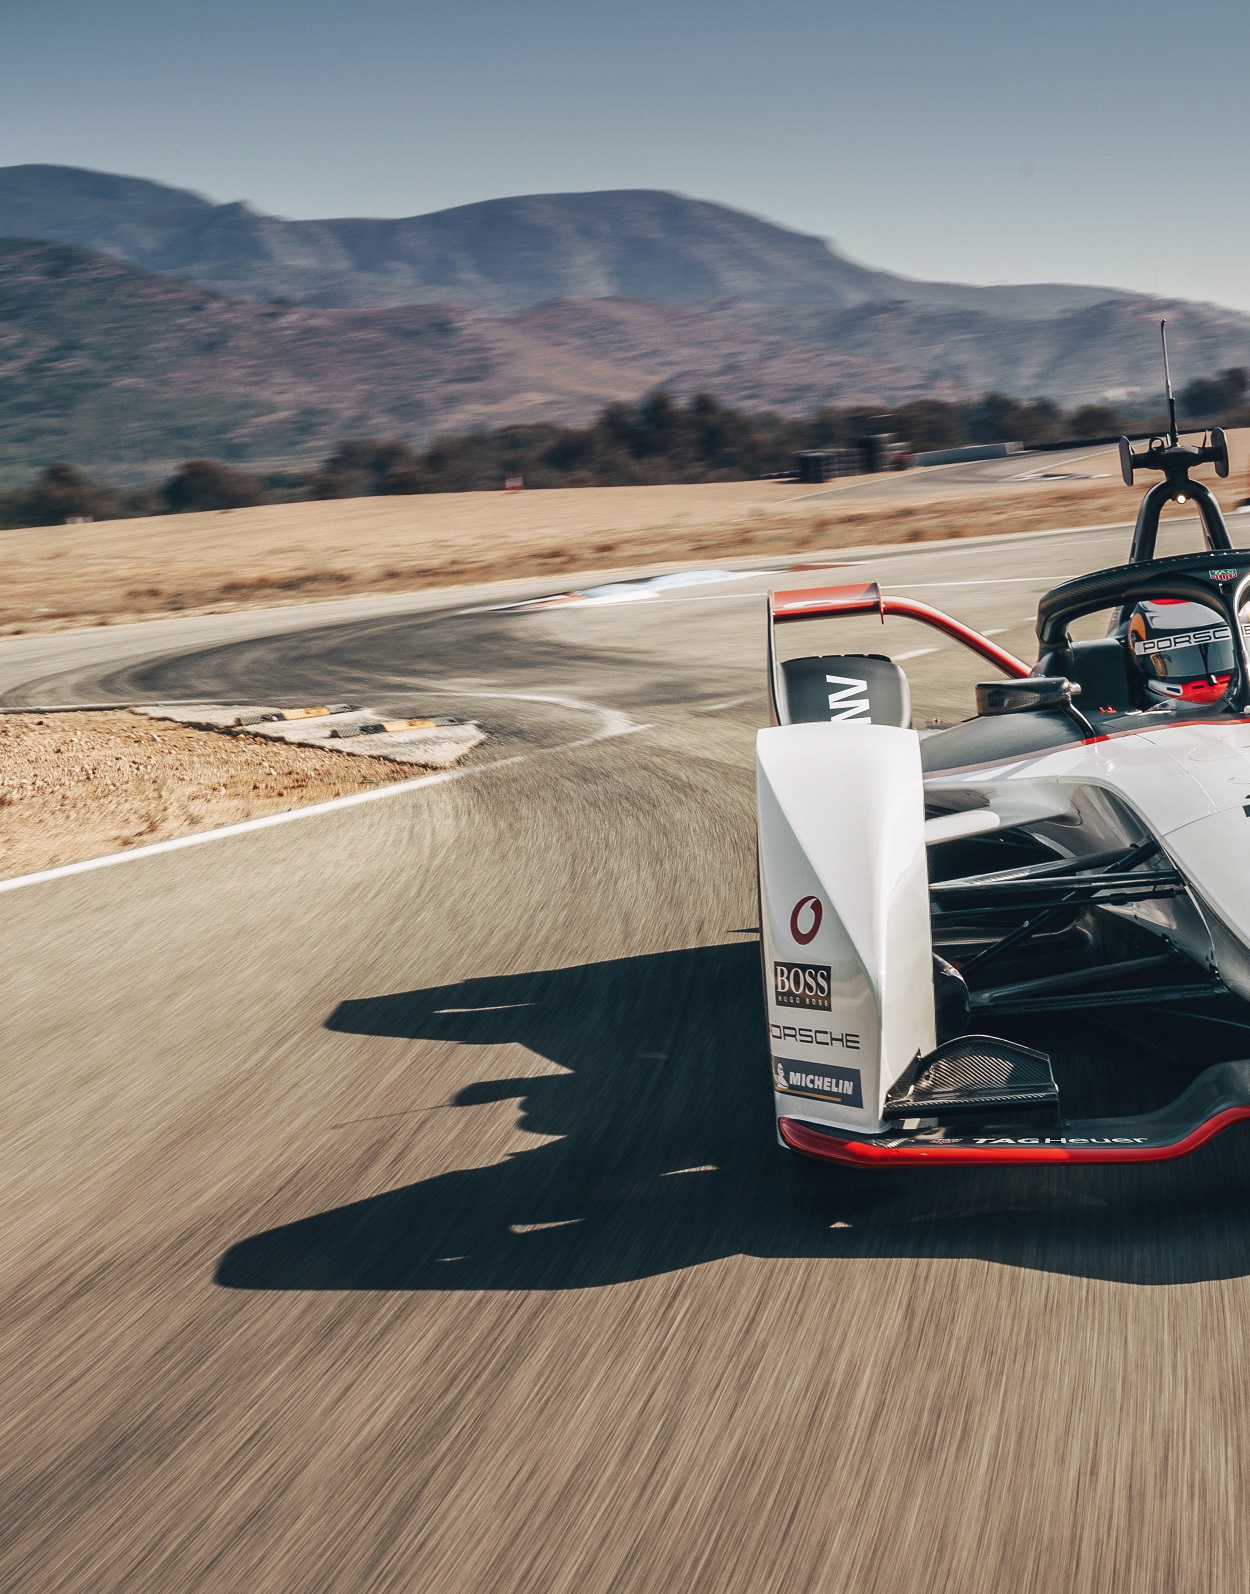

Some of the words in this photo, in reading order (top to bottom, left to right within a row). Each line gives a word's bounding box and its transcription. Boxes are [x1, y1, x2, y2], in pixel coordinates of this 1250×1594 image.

[776, 965, 829, 997] BOSS
[778, 995, 800, 1004] HUGO
[805, 998, 829, 1007] BOSS
[769, 1022, 861, 1050] ORSCHE
[789, 1071, 854, 1095] MICHELIN
